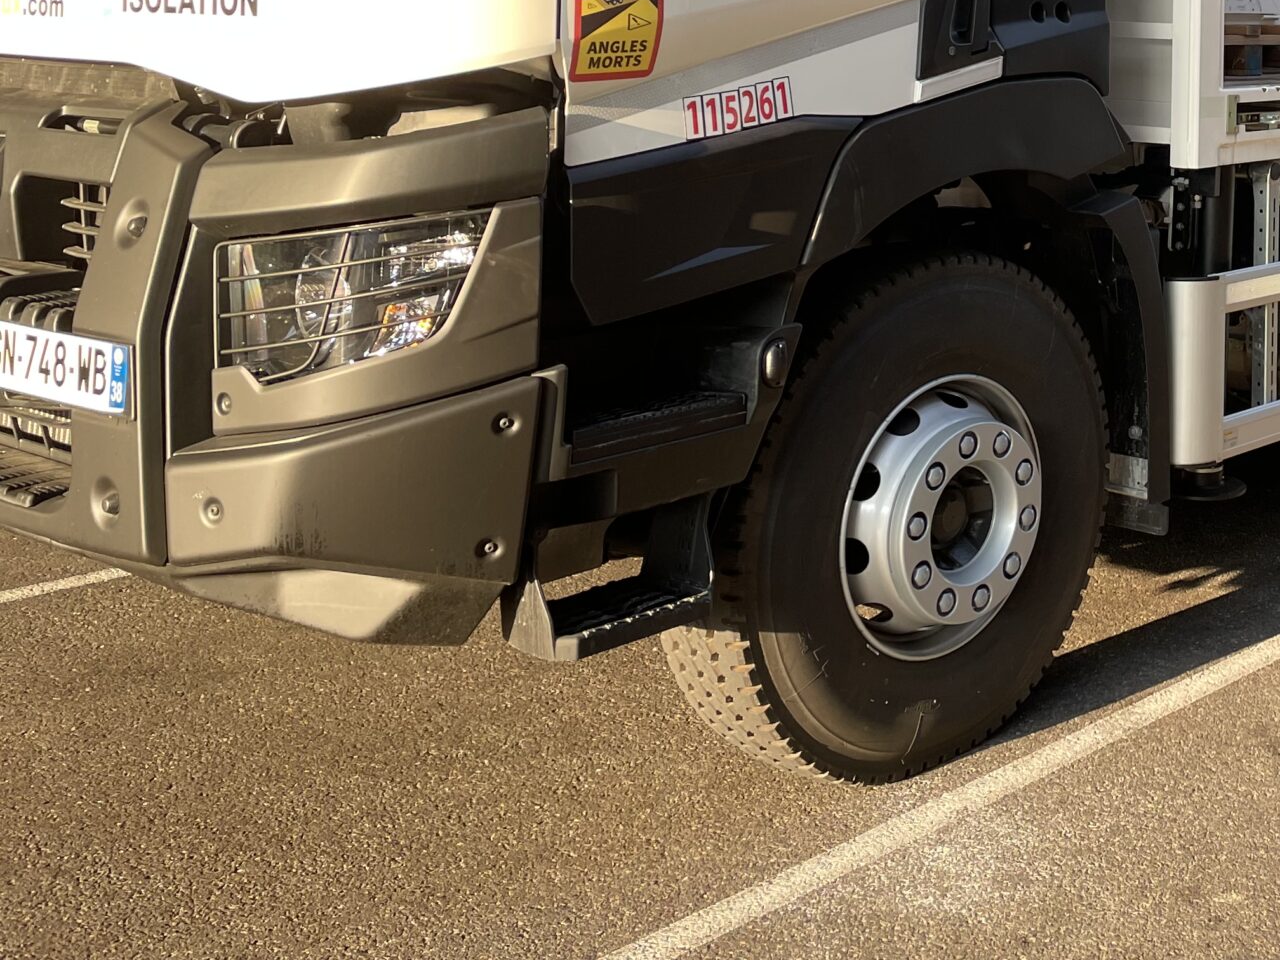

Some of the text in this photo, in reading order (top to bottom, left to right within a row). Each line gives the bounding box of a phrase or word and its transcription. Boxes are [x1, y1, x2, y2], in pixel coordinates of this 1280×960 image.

[587, 39, 648, 55] ANGLES
[588, 54, 642, 70] MORTS
[686, 81, 789, 135] 115261
[0, 329, 107, 396] N-748-WB
[110, 380, 123, 404] 38
